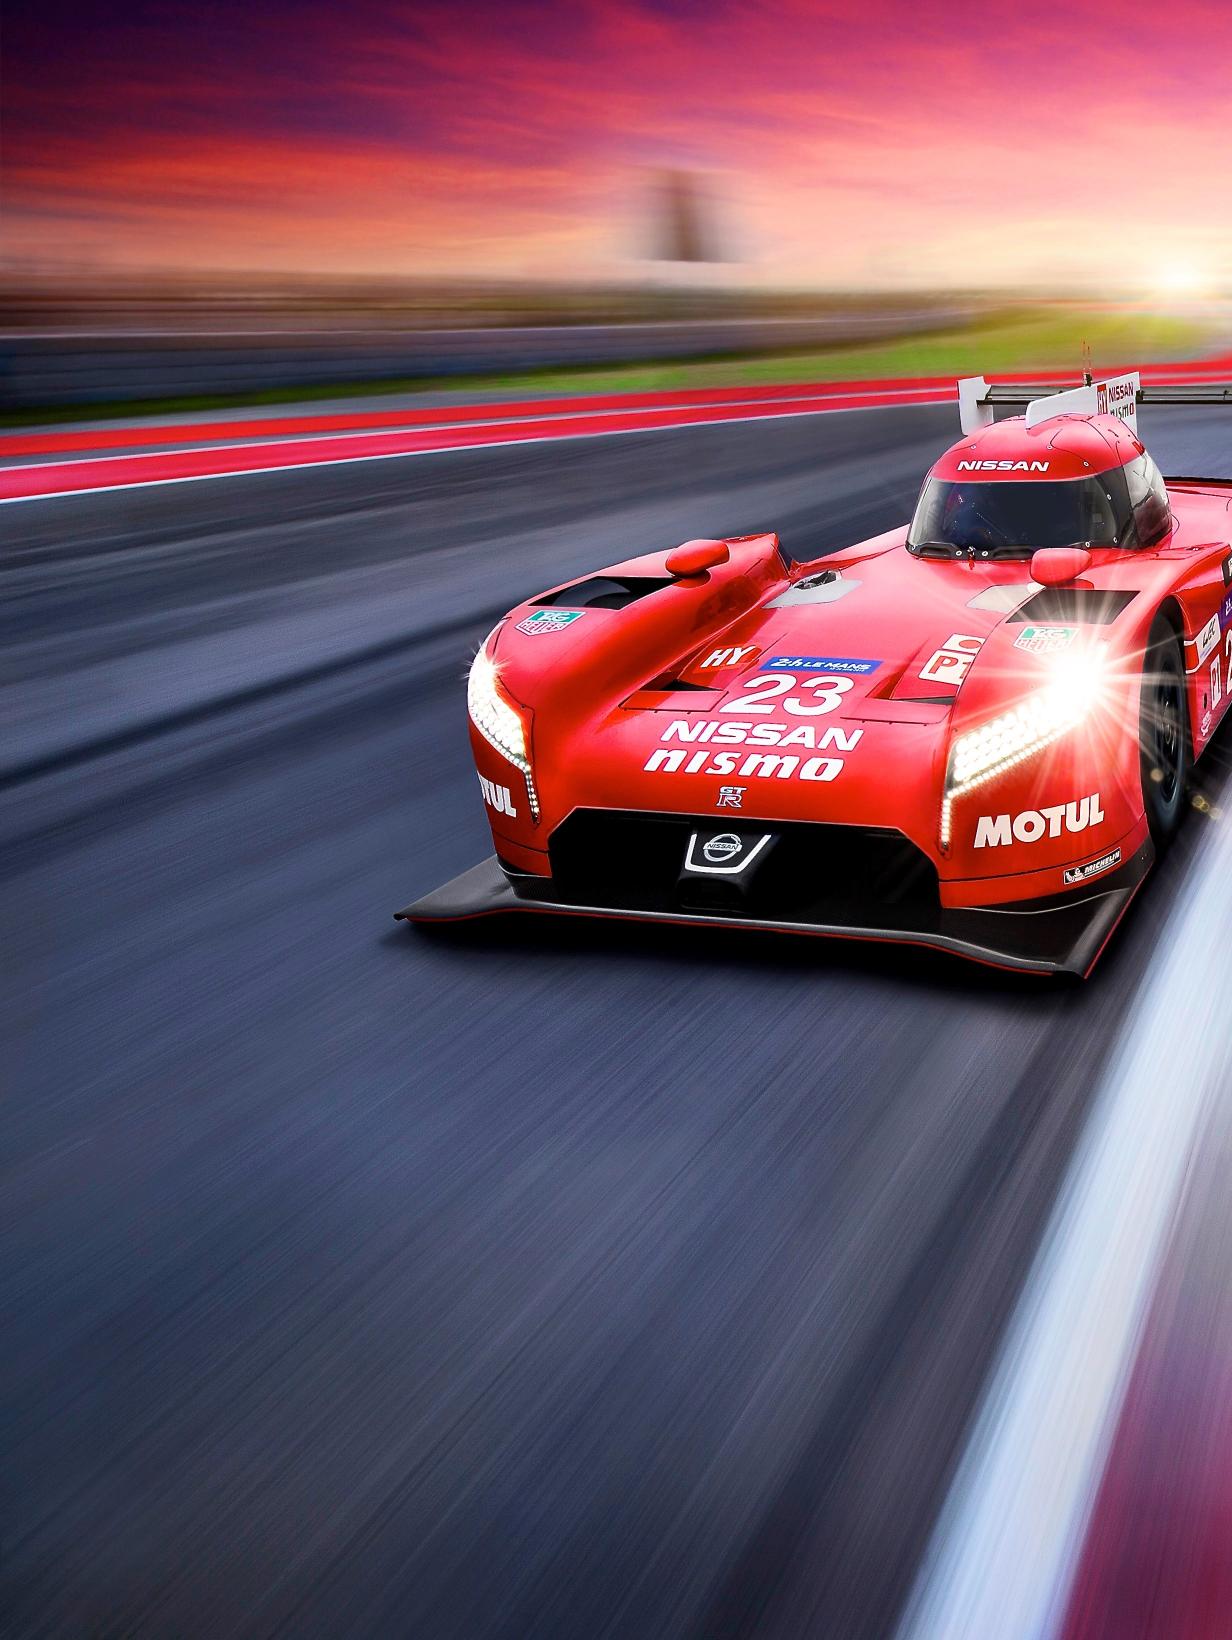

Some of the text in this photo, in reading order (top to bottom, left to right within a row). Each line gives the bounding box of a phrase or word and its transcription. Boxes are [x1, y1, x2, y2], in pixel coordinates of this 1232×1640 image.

[1109, 382, 1134, 403] NISSAN
[956, 459, 1051, 472] NISSAN
[700, 646, 756, 669] HY
[823, 662, 872, 671] MANS
[928, 655, 972, 679] P1
[718, 673, 855, 716] 23
[660, 720, 864, 752] NISSAN
[477, 770, 517, 818] TUL
[973, 792, 1105, 849] MOTUL
[706, 843, 739, 851] NISSAN
[1084, 850, 1121, 874] MICHELIN
